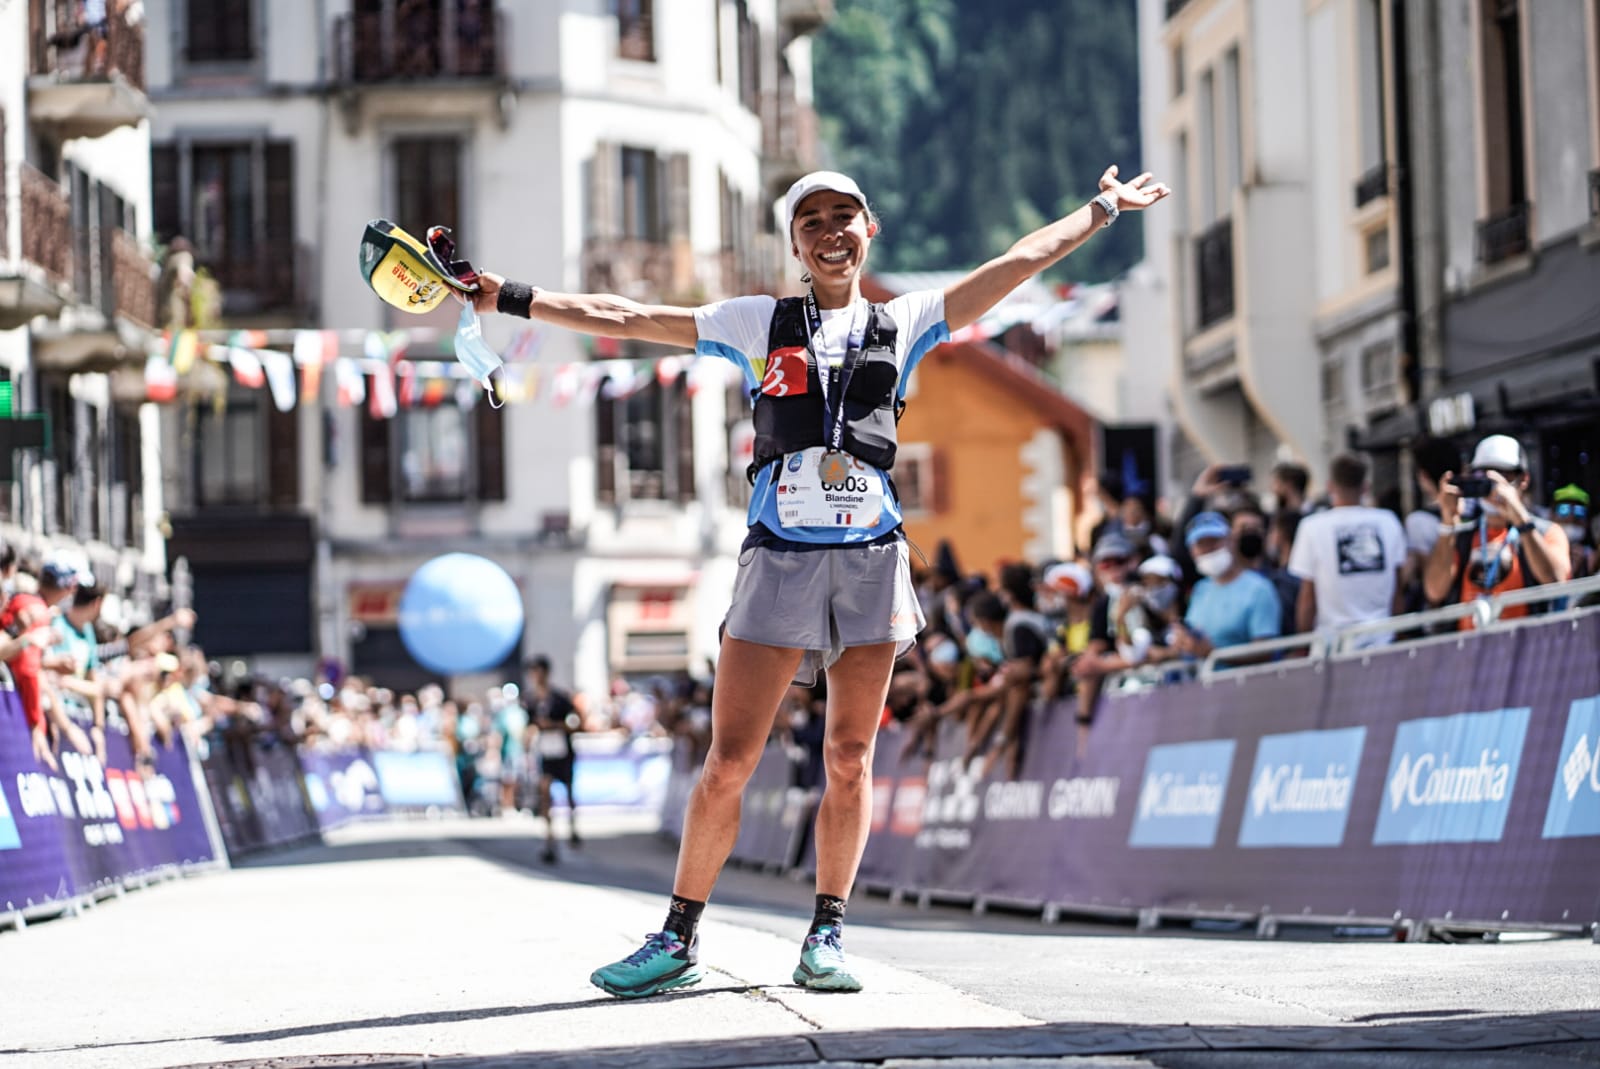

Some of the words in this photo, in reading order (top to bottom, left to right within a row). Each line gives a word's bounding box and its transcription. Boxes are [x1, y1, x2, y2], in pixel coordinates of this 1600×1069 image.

[392, 266, 418, 290] UTMB
[825, 493, 864, 503] Blandine
[1408, 748, 1510, 806] Columbia
